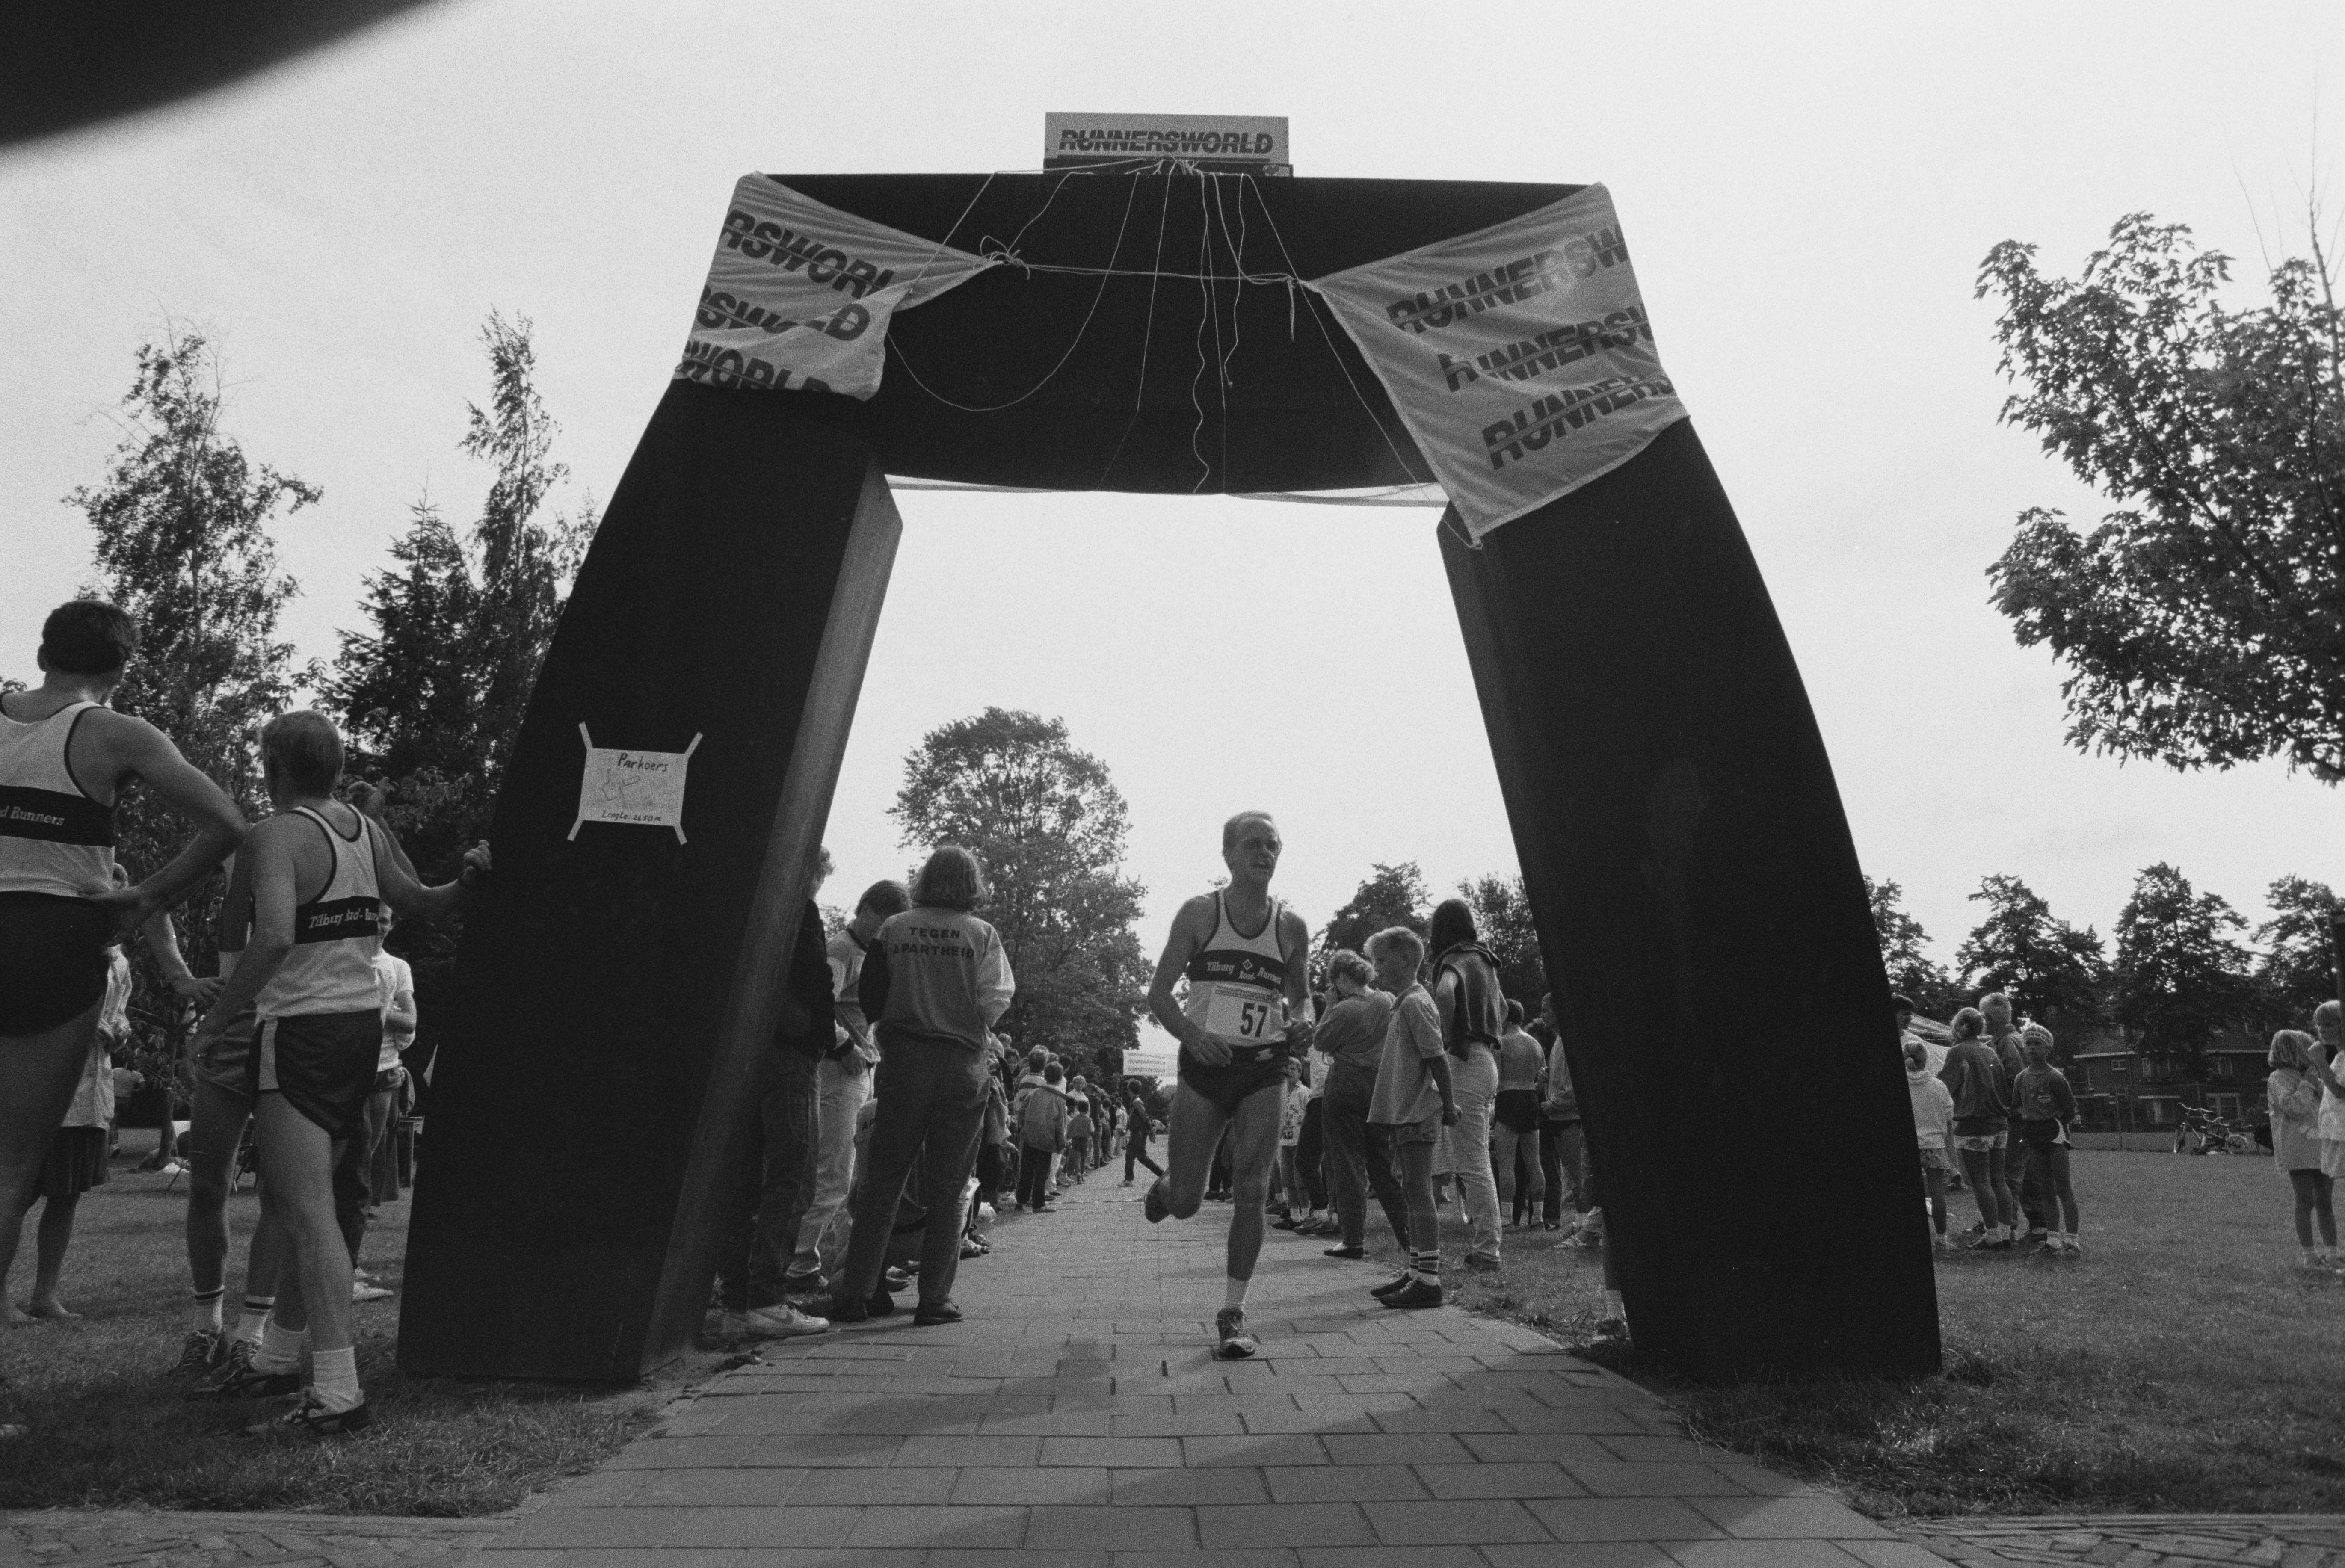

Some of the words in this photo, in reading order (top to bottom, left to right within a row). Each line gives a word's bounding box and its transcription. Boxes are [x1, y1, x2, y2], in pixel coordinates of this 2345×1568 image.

[1058, 129, 1273, 154] RUNNERSWORLD
[618, 752, 669, 772] Parkoers
[10, 806, 65, 825] Runners
[909, 926, 961, 939] TEGEN
[893, 943, 975, 958] APARTHEID
[1207, 961, 1235, 974] Tilburg
[1240, 1002, 1268, 1038] 57
